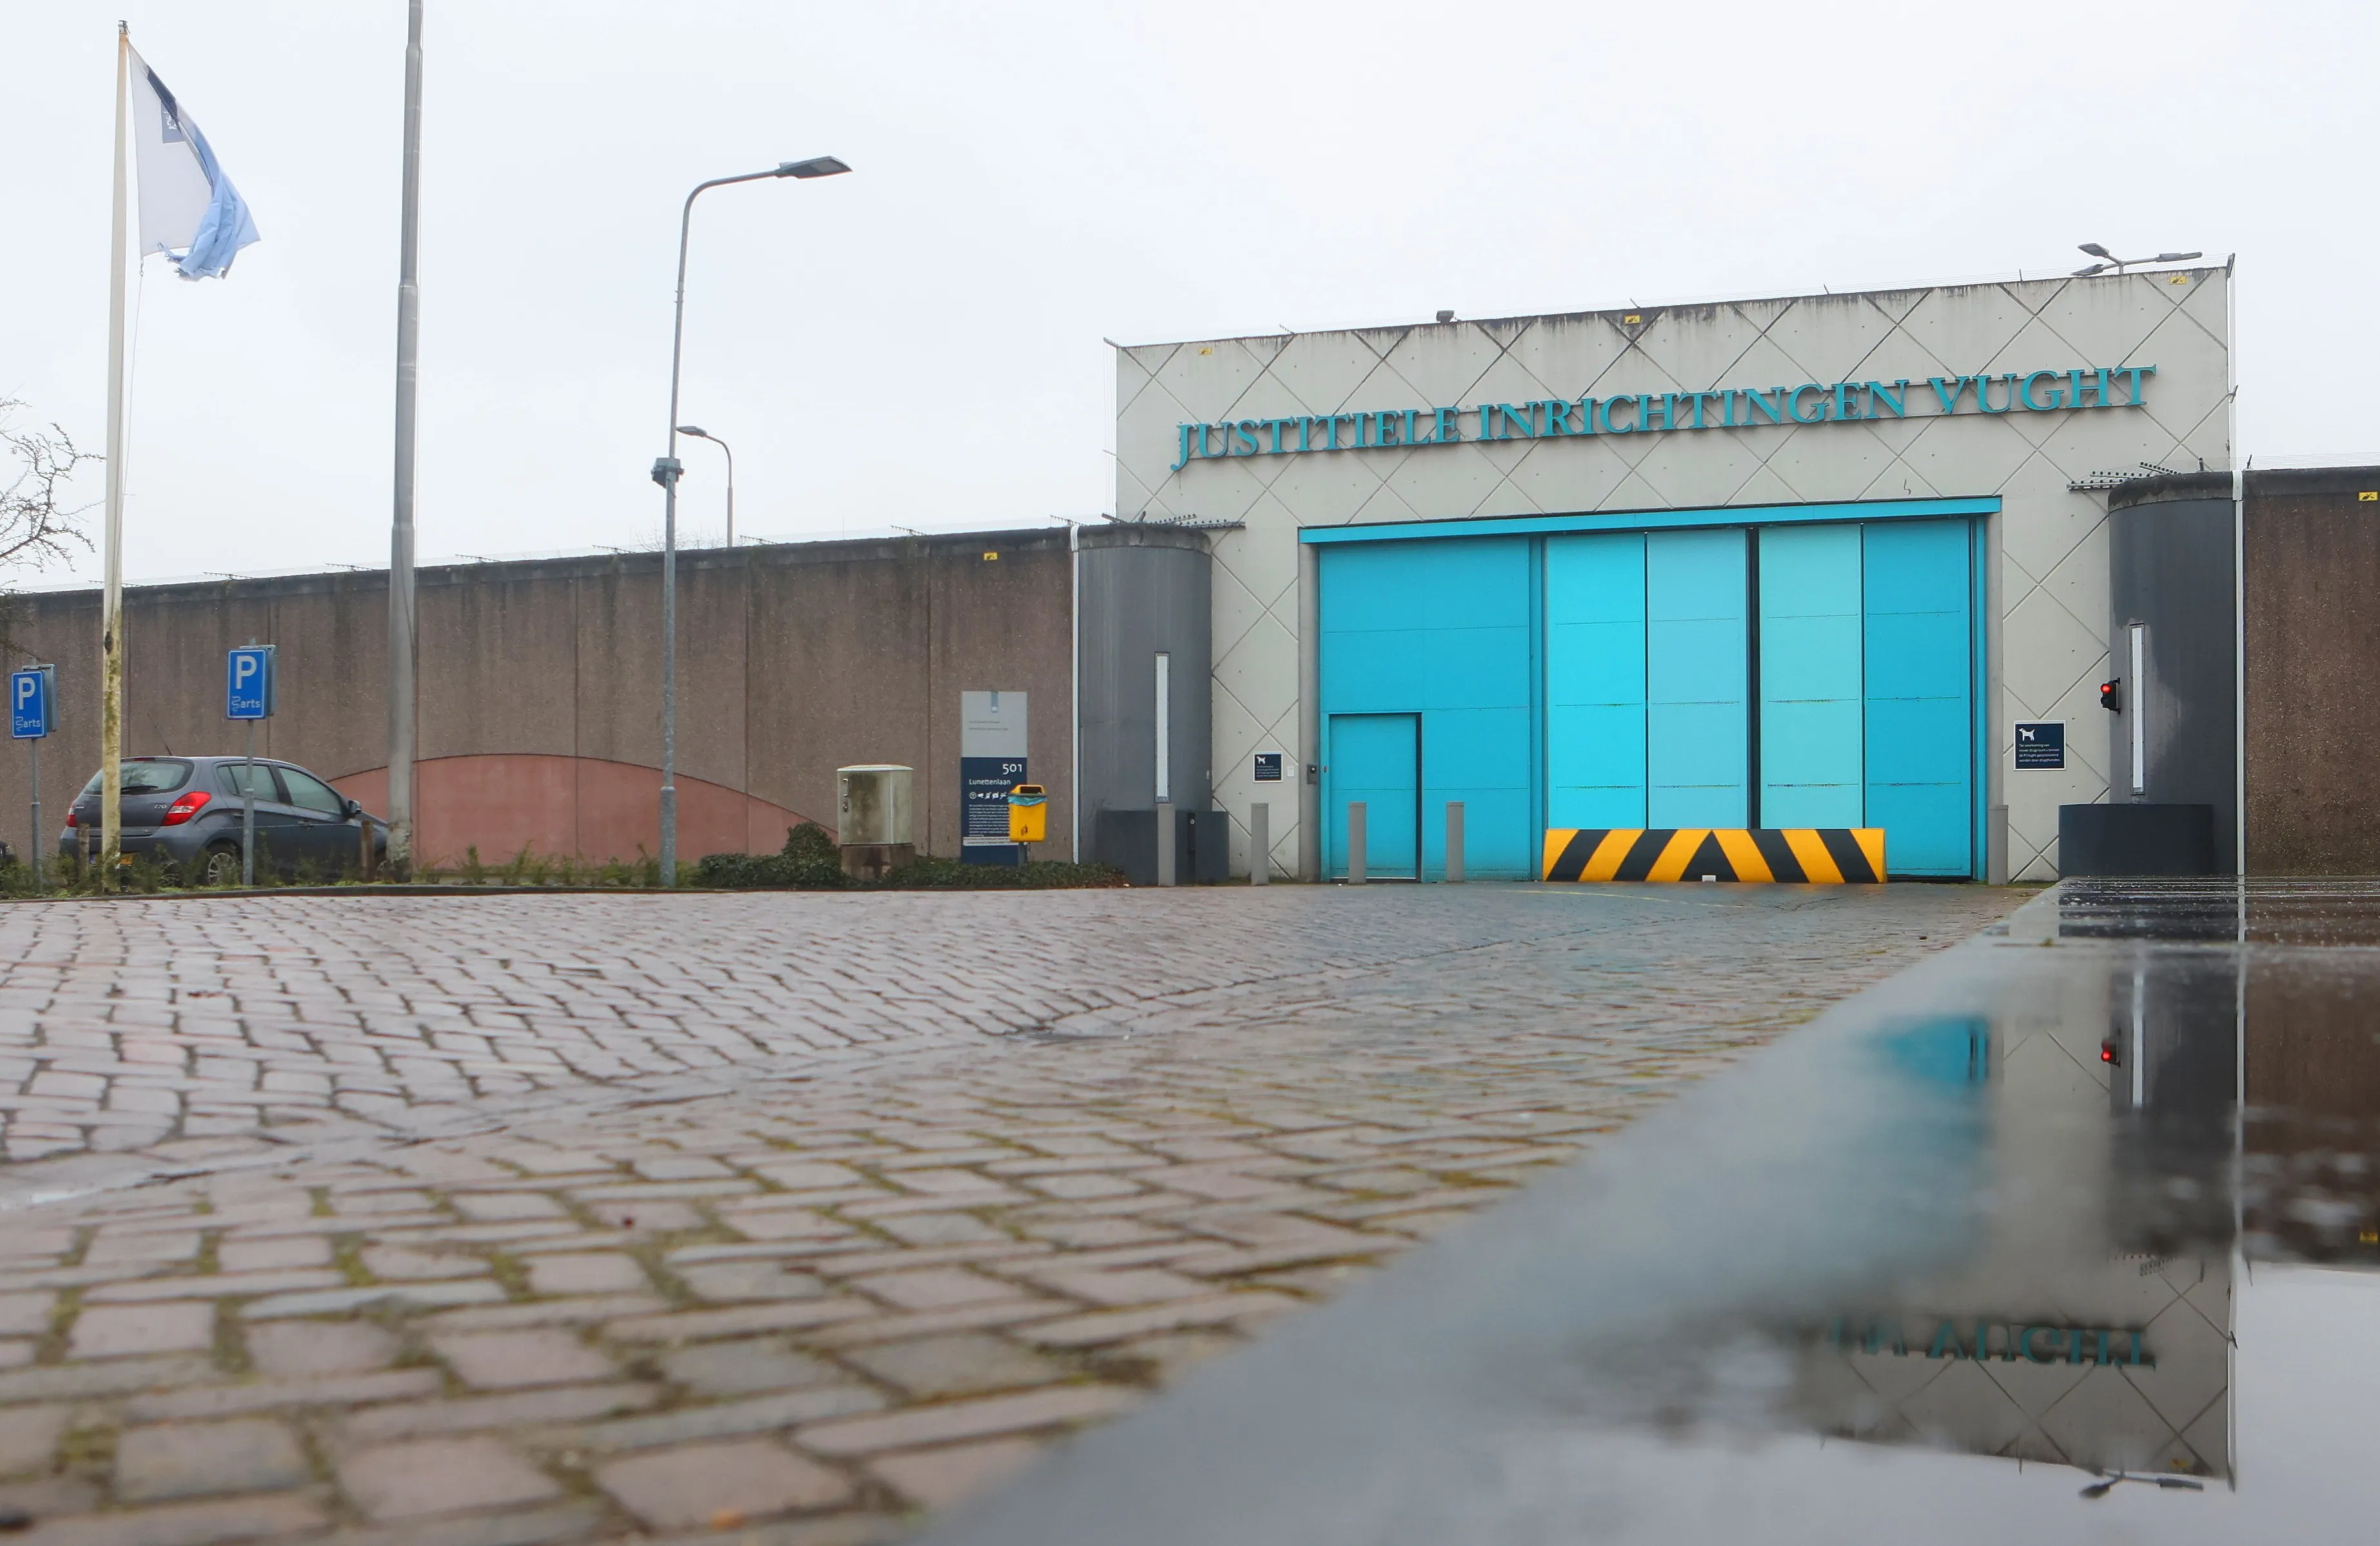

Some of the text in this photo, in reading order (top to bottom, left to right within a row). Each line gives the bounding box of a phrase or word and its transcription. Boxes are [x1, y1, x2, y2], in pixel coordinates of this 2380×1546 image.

[1170, 366, 2156, 471] JUSTITIELE INRICHTINGEN VUGHT
[236, 655, 257, 689] P
[18, 677, 36, 710] P
[240, 699, 261, 708] arts
[1002, 764, 1022, 775] 501
